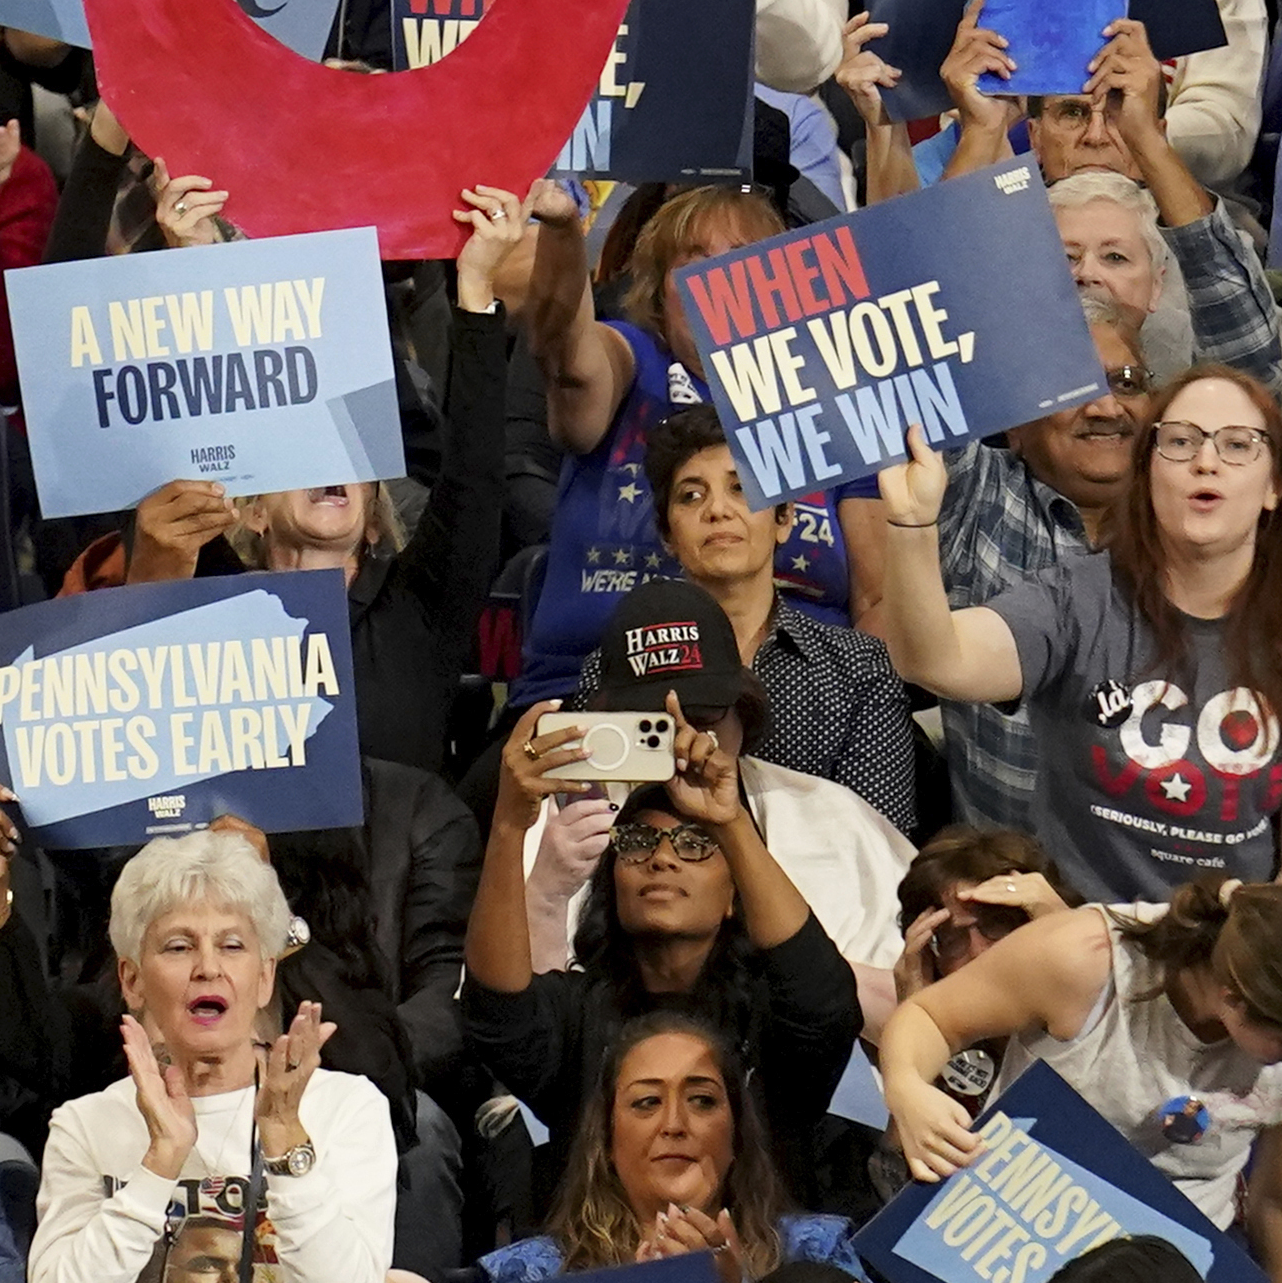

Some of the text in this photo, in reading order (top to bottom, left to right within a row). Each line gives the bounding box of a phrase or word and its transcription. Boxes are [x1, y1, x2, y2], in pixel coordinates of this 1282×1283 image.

[685, 225, 871, 346] WHEN
[70, 277, 326, 368] A NEW WAY
[710, 326, 819, 423] WE
[807, 279, 976, 381] VOTE,
[92, 345, 319, 429] FORWARD
[190, 444, 237, 465] HARRIS
[735, 360, 969, 500] WE WIN
[199, 459, 231, 473] WALZ
[625, 625, 700, 656] HARRIS
[627, 648, 680, 677] WALZ
[15, 702, 312, 788] VOTES EARLY
[1119, 679, 1281, 776] GO
[147, 794, 186, 813] HARRIS
[1150, 848, 1194, 865] square
[1170, 826, 1223, 844] PLEASE
